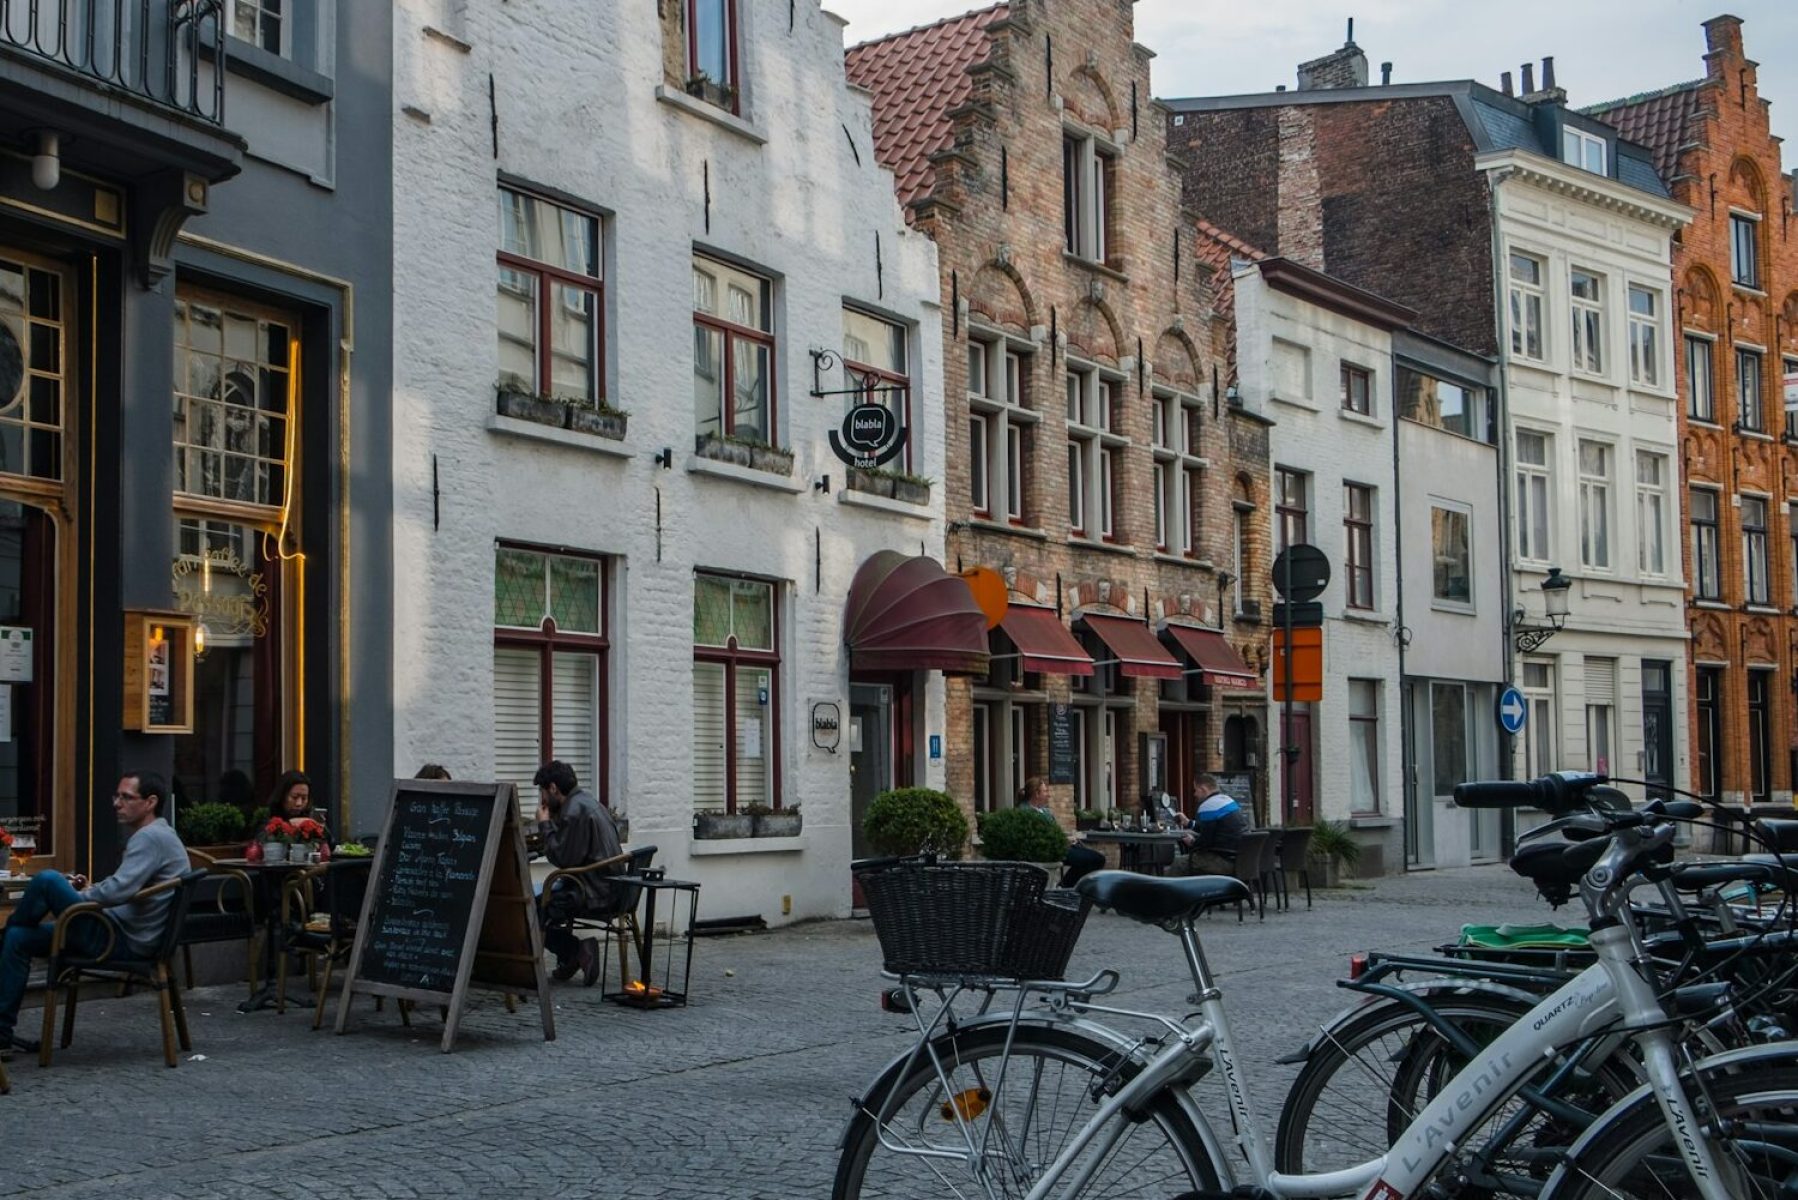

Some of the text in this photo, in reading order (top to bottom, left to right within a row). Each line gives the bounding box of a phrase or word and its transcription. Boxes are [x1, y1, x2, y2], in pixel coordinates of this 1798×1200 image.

[855, 419, 882, 430] blabla
[854, 457, 877, 468] hotel
[815, 717, 838, 730] blabla
[1533, 995, 1575, 1031] QUARTZ
[1219, 1048, 1249, 1118] L'Avenir
[1401, 1051, 1513, 1174] L'Avenir
[1666, 1097, 1710, 1179] L'Avenir
